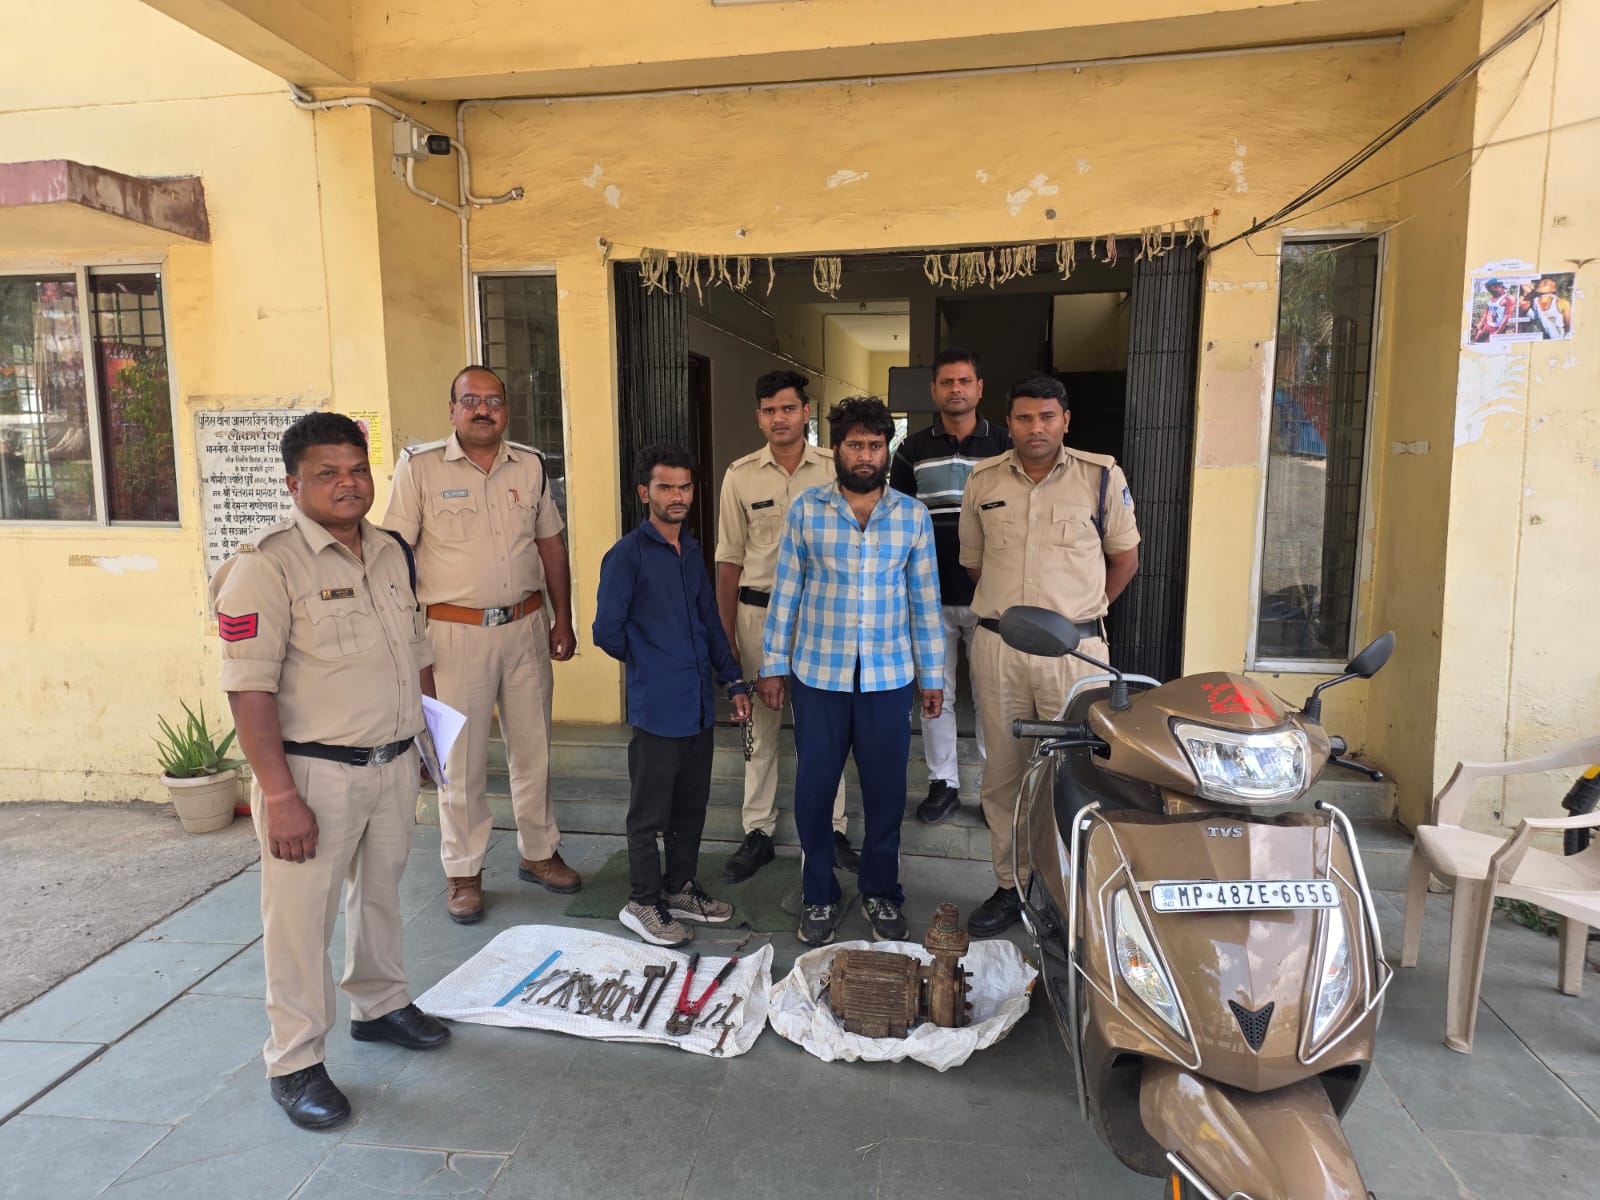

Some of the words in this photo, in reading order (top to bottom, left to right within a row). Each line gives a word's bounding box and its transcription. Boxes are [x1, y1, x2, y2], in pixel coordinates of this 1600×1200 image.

[227, 428, 282, 441] लोकार्पण
[1207, 826, 1244, 838] TVS
[1178, 886, 1202, 907] MP
[1217, 884, 1270, 905] 48ZE
[1280, 884, 1332, 904] 6656
